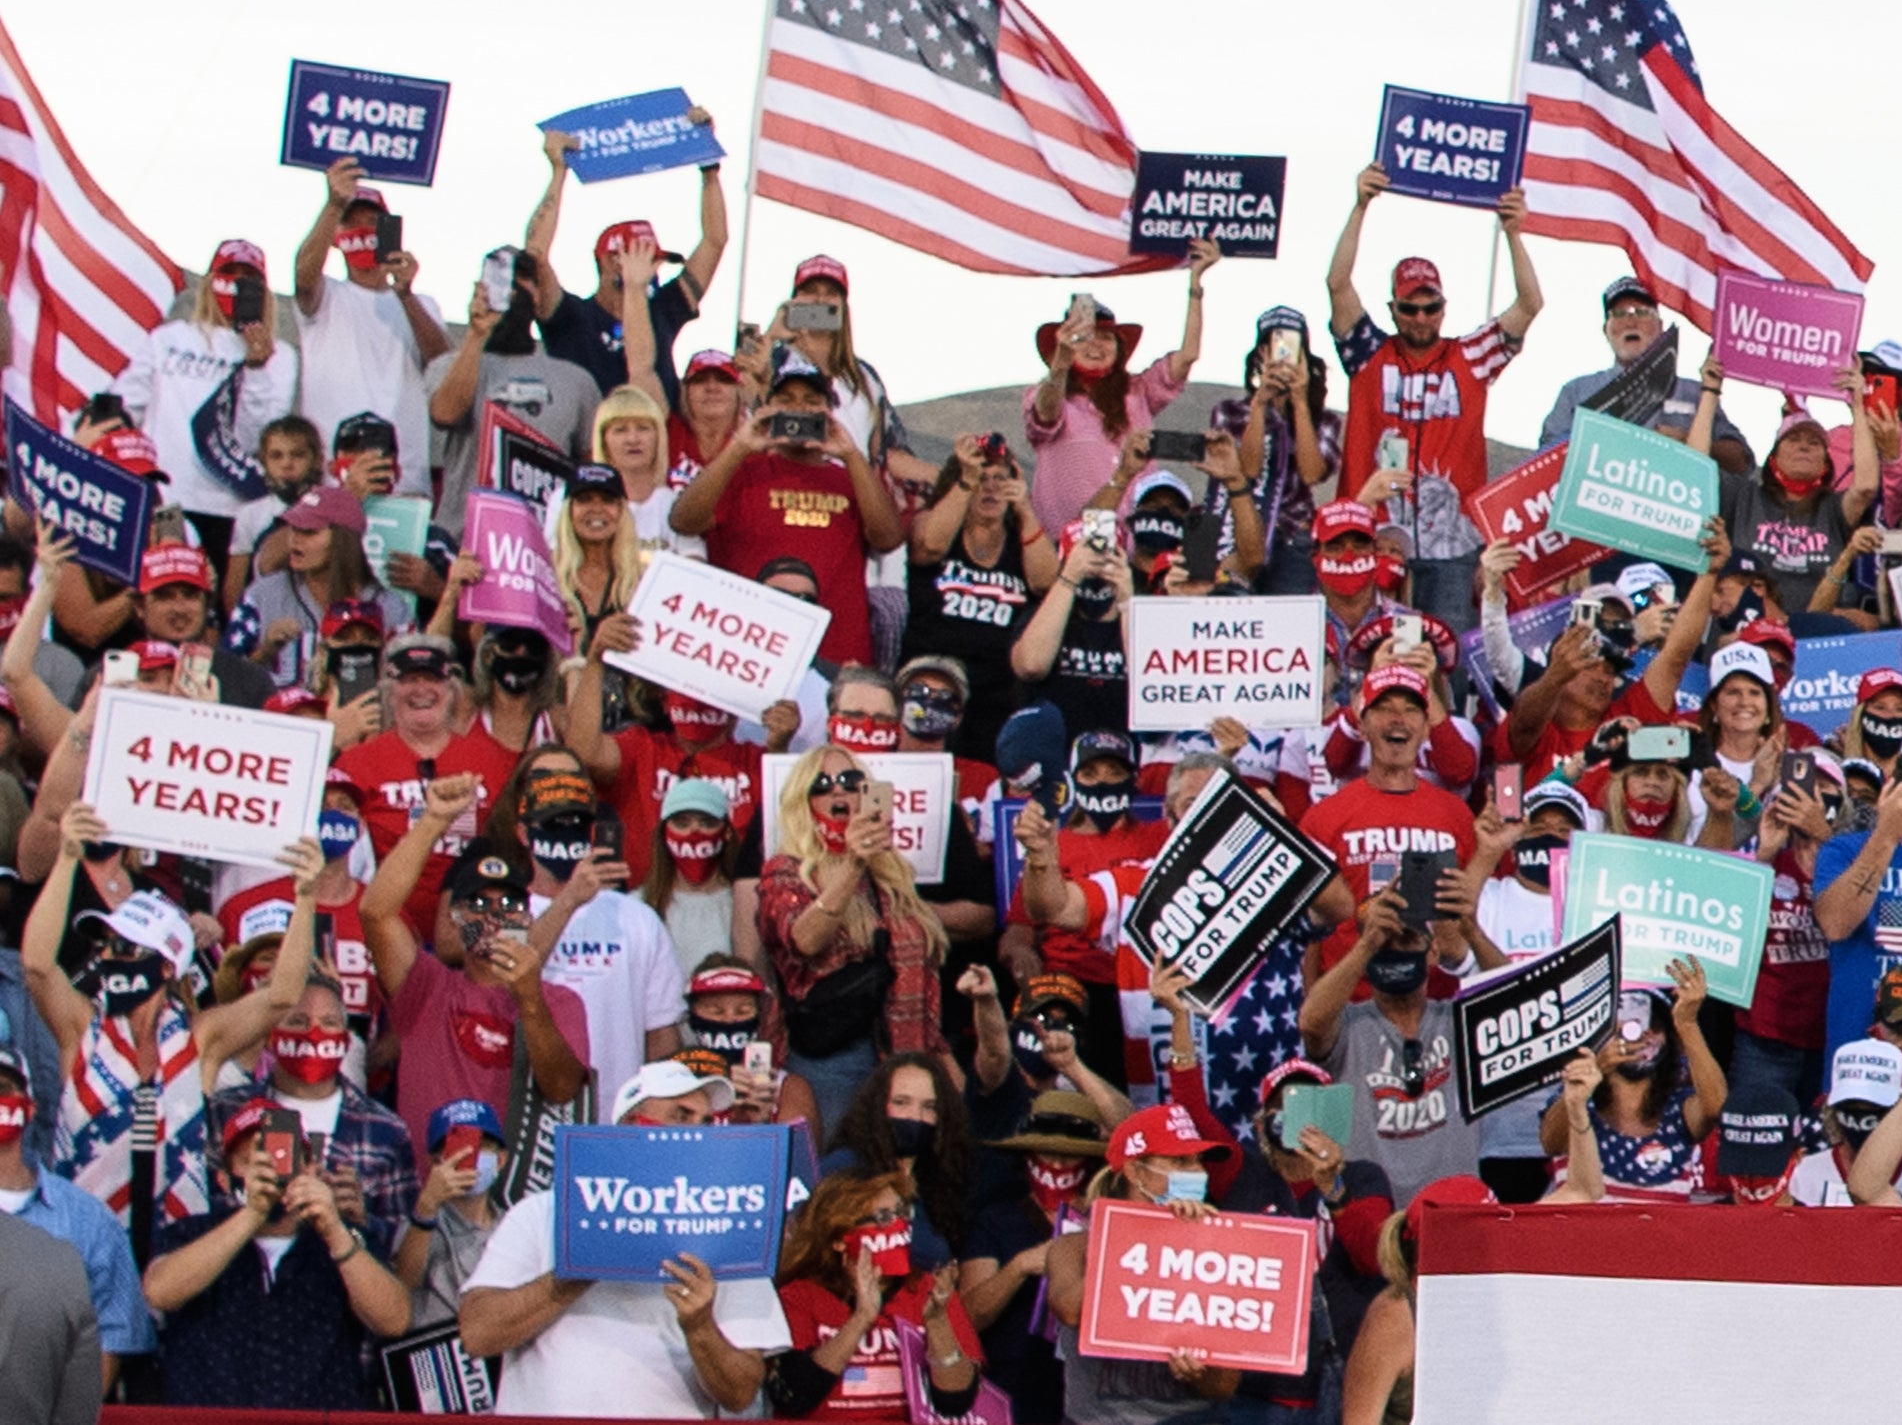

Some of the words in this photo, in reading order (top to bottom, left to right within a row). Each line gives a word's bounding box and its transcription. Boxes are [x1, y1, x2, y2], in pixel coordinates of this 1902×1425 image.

[307, 92, 330, 118] 4
[337, 95, 427, 130] MORE
[307, 123, 418, 161] YEARS!
[1395, 115, 1416, 139] 4
[1420, 121, 1506, 153] MORE
[1184, 170, 1243, 190] MAKE
[1395, 144, 1501, 183] YEARS!
[1142, 191, 1277, 219] AMERICA
[1140, 219, 1208, 241] GREAT
[1212, 222, 1277, 243] AGAIN
[1729, 303, 1842, 356] Women
[1735, 339, 1769, 359] FOR
[1772, 347, 1828, 370] TRUMP
[35, 453, 127, 523] MORE
[1587, 443, 1702, 510] Latinos
[769, 489, 850, 514] TRUMP
[1583, 487, 1625, 514] FOR
[1630, 499, 1695, 533] TRUMP
[1502, 507, 1524, 535] 4
[941, 559, 1026, 593] Trump
[1320, 556, 1376, 576] MAGA
[661, 592, 683, 616] 4
[689, 601, 790, 659] MORE
[942, 593, 1012, 626] 2020
[1193, 620, 1265, 640] MAKE
[651, 621, 773, 689] YEARS!
[1143, 647, 1311, 675] AMERICA
[1721, 647, 1759, 667] USA
[1141, 683, 1222, 704] GREAT
[1235, 683, 1311, 703] AGAIN
[1789, 698, 1821, 713] FOR
[1824, 695, 1857, 711] TRU
[835, 723, 897, 746] MAGA
[128, 736, 153, 763] 4
[168, 740, 292, 785] MORE
[127, 777, 282, 827] YEARS!
[1077, 792, 1130, 812] MAGA
[1343, 827, 1456, 855] TRUMP
[1150, 868, 1226, 959] COPS
[1184, 927, 1228, 978] FOR
[1226, 852, 1292, 925] TRUMP
[1596, 867, 1744, 931] Latinos
[1658, 925, 1735, 956] TRUMP
[1476, 990, 1562, 1056] COPS
[277, 1038, 346, 1058] MAGA
[1484, 1051, 1534, 1083] FOR
[1542, 1003, 1611, 1056] TRUMP
[1378, 1094, 1446, 1132] 2020
[1124, 1131, 1148, 1156] 45
[575, 1175, 765, 1215] Workers
[614, 1217, 658, 1234] FOR
[665, 1218, 733, 1234] TRUMP
[1120, 1244, 1149, 1274] 4
[1160, 1248, 1282, 1291] MORE
[1120, 1285, 1274, 1333] YEARS!
